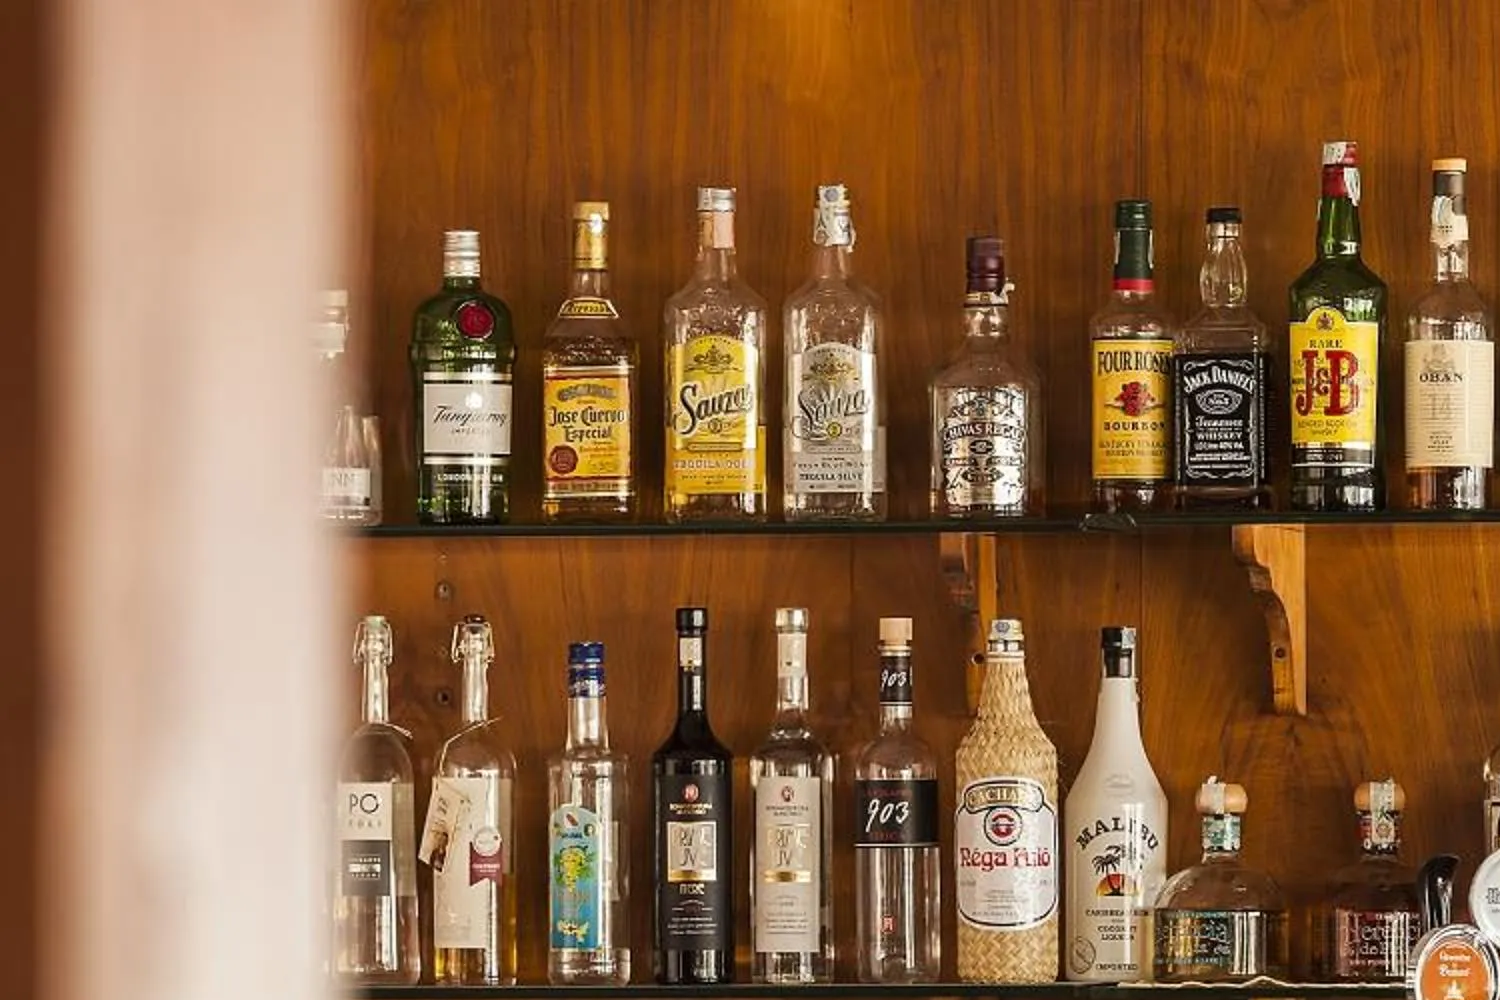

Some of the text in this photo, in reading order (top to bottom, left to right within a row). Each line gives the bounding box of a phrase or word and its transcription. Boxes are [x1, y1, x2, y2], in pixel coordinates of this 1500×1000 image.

[1309, 340, 1343, 349] RARE
[1097, 351, 1133, 376] FOUR
[1183, 371, 1213, 394] JACK
[1296, 350, 1360, 416] J&B
[1419, 372, 1463, 383] OBAN
[433, 405, 507, 428] Tanqray
[580, 405, 626, 424] Cuervo
[673, 383, 754, 435] Sauza
[564, 425, 613, 443] Especial
[1103, 421, 1165, 431] BOURBON
[881, 668, 907, 689] 903
[966, 786, 1038, 805] CACHA
[865, 798, 909, 833] 903
[1076, 817, 1159, 850] MALIBU
[1085, 909, 1129, 917] CARIBBEA
[1097, 925, 1137, 933] COCONT
